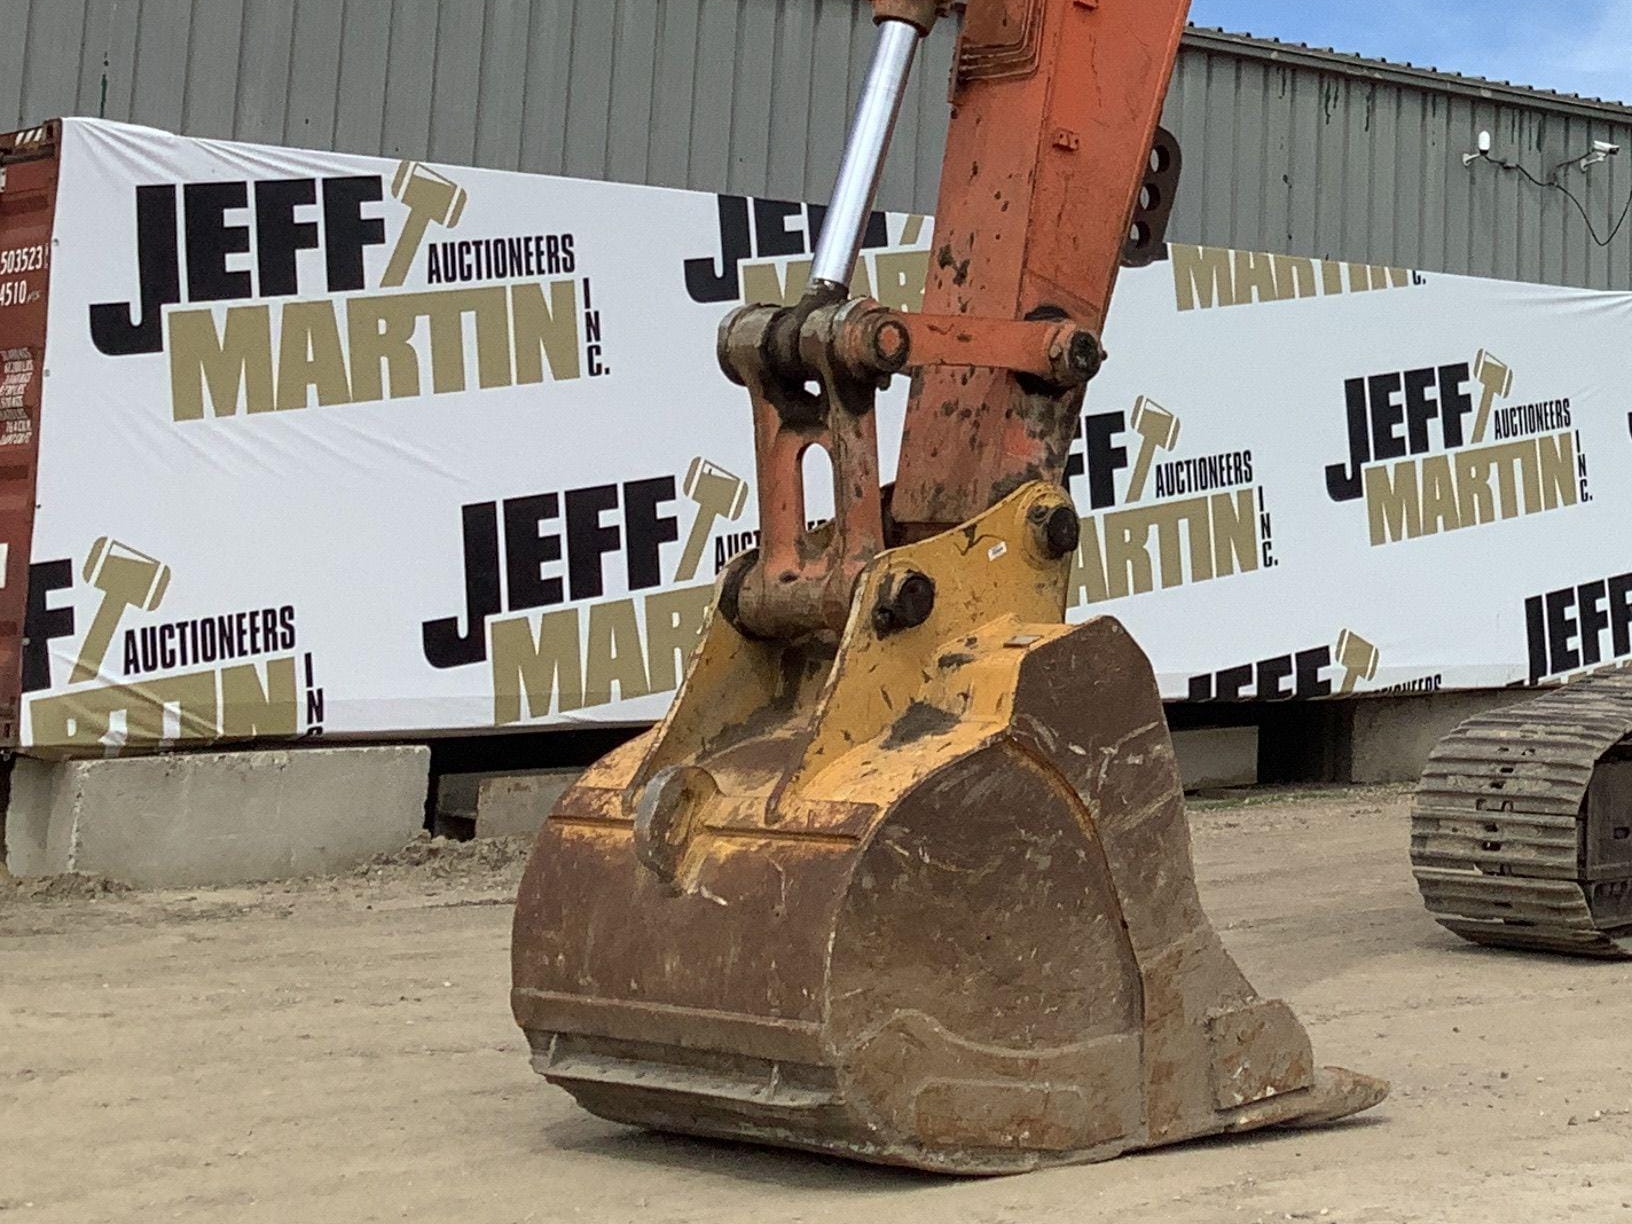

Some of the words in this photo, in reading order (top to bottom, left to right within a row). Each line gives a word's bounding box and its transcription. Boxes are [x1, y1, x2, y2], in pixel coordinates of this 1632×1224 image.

[0, 245, 43, 275] 503523
[89, 175, 385, 356] JEFF
[427, 234, 576, 284] AUCTIONEERS
[167, 279, 580, 422] MARTIN
[1156, 450, 1253, 498] AUCTIONEERS
[1325, 362, 1472, 502] JEFF
[1494, 397, 1571, 440] AUCTIONEERS
[1066, 488, 1259, 608] ARTIN
[1364, 432, 1577, 547] MARTIN
[422, 475, 678, 669] JEFF
[123, 605, 296, 676] AUCTIONEERS
[491, 584, 715, 726] MAR
